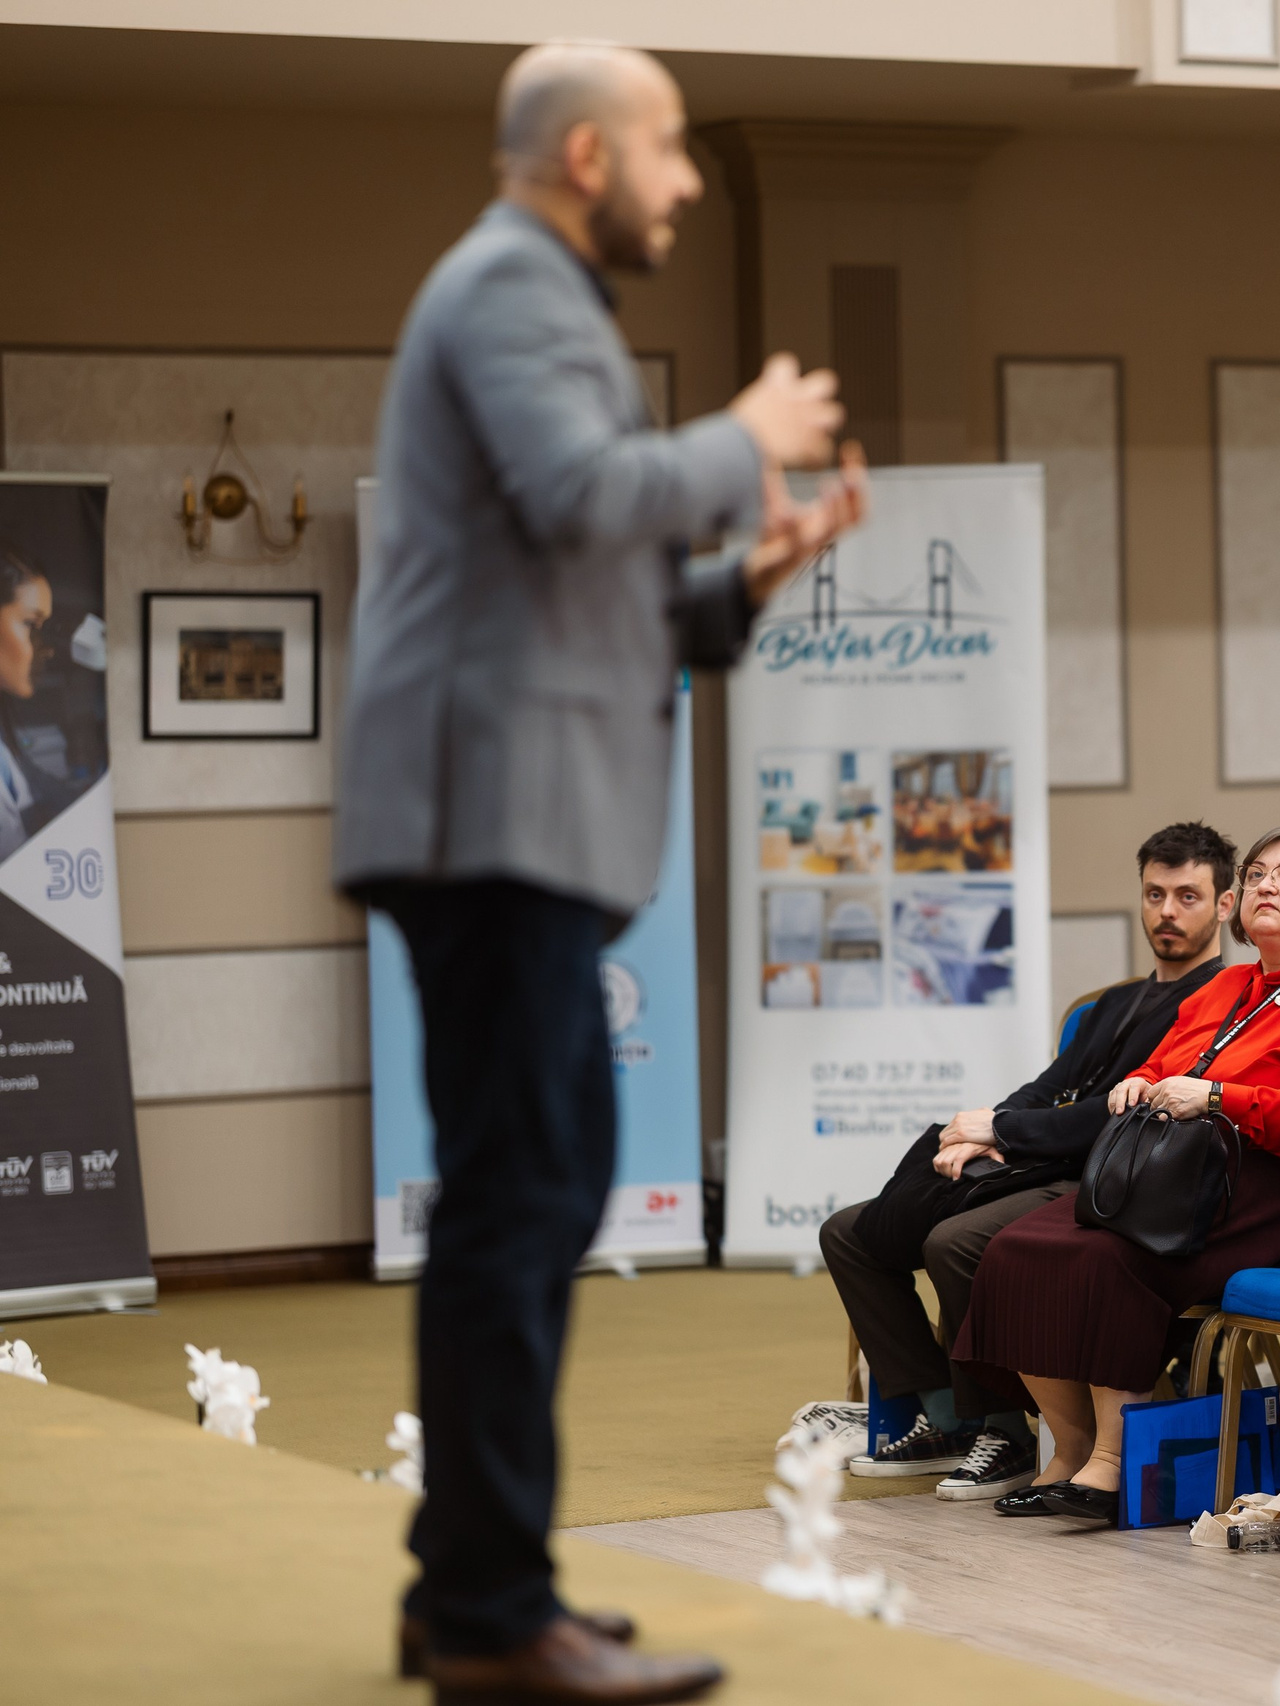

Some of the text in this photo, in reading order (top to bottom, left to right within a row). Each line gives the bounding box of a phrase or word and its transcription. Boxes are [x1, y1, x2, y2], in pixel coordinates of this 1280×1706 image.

[45, 847, 103, 900] 30
[0, 974, 88, 1006] ONTINUĂ
[765, 1193, 838, 1228] bosf
